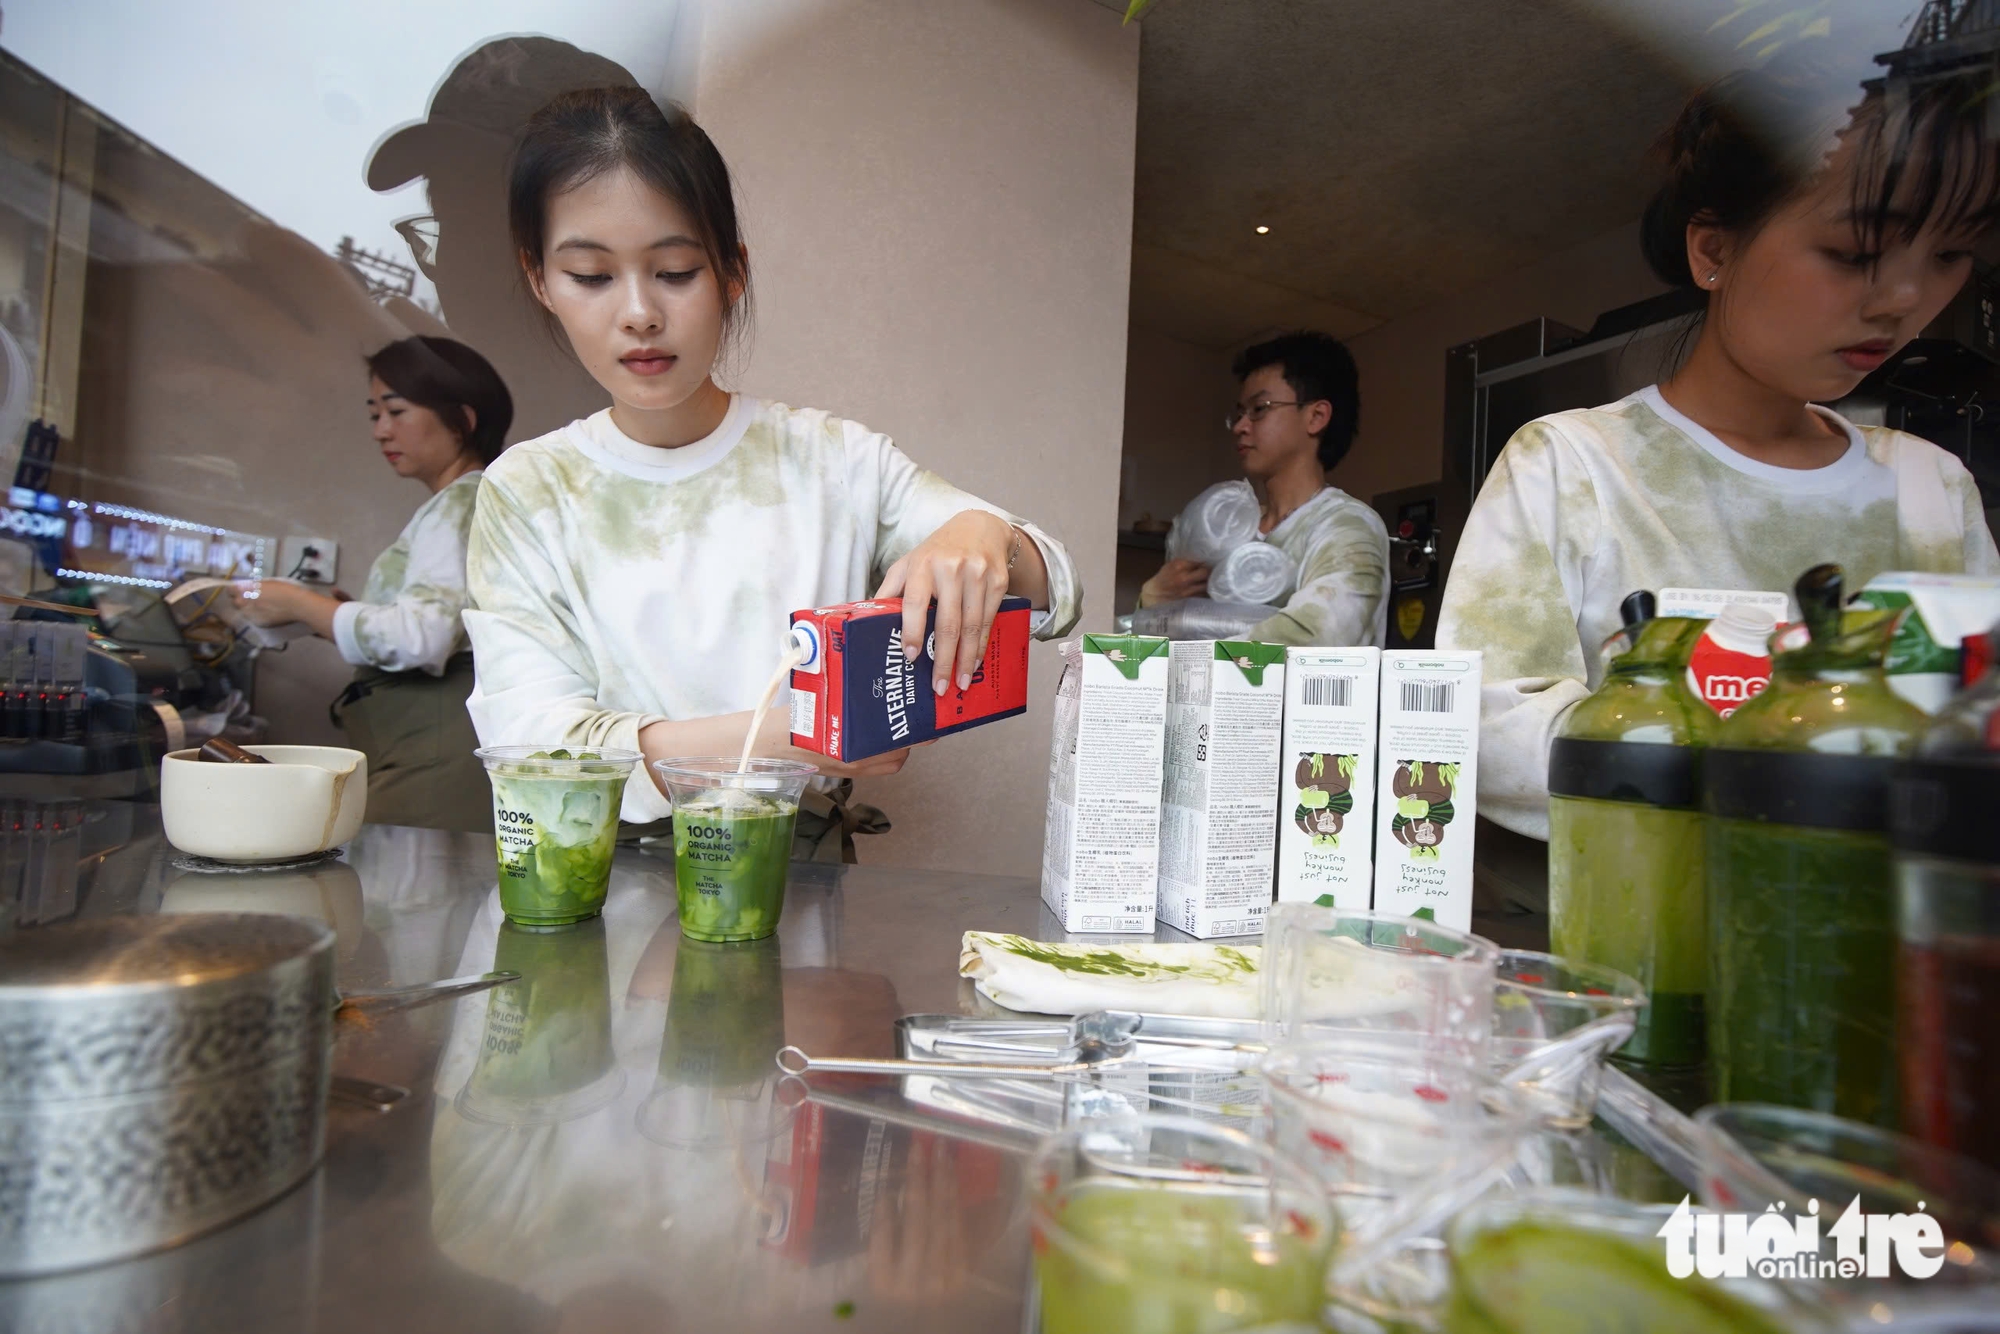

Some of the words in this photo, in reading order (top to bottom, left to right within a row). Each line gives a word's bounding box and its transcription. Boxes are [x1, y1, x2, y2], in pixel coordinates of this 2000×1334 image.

[830, 628, 843, 653] OAT
[872, 676, 884, 698] The
[885, 628, 910, 740] ALTERNATIVE
[905, 674, 916, 705] DAIRY
[831, 714, 839, 729] ME
[830, 730, 839, 756] SHAKE
[498, 809, 534, 825] 100%
[499, 824, 534, 836] ORGANIC
[687, 825, 732, 840] 100%
[499, 836, 534, 846] MATCHA
[687, 840, 732, 852] ORGANIC
[688, 851, 732, 862] MATCHA
[1304, 852, 1346, 864] business
[505, 863, 528, 872] MATCHA
[1305, 860, 1343, 872] monkey
[1401, 864, 1446, 878] business
[507, 870, 526, 878] TOKYO
[1299, 872, 1322, 880] just
[1325, 874, 1348, 882] Not
[1402, 873, 1444, 886] monkey
[695, 881, 723, 890] MATCHA
[1396, 885, 1420, 894] just
[698, 888, 720, 896] TOKYO
[1424, 888, 1449, 896] Not
